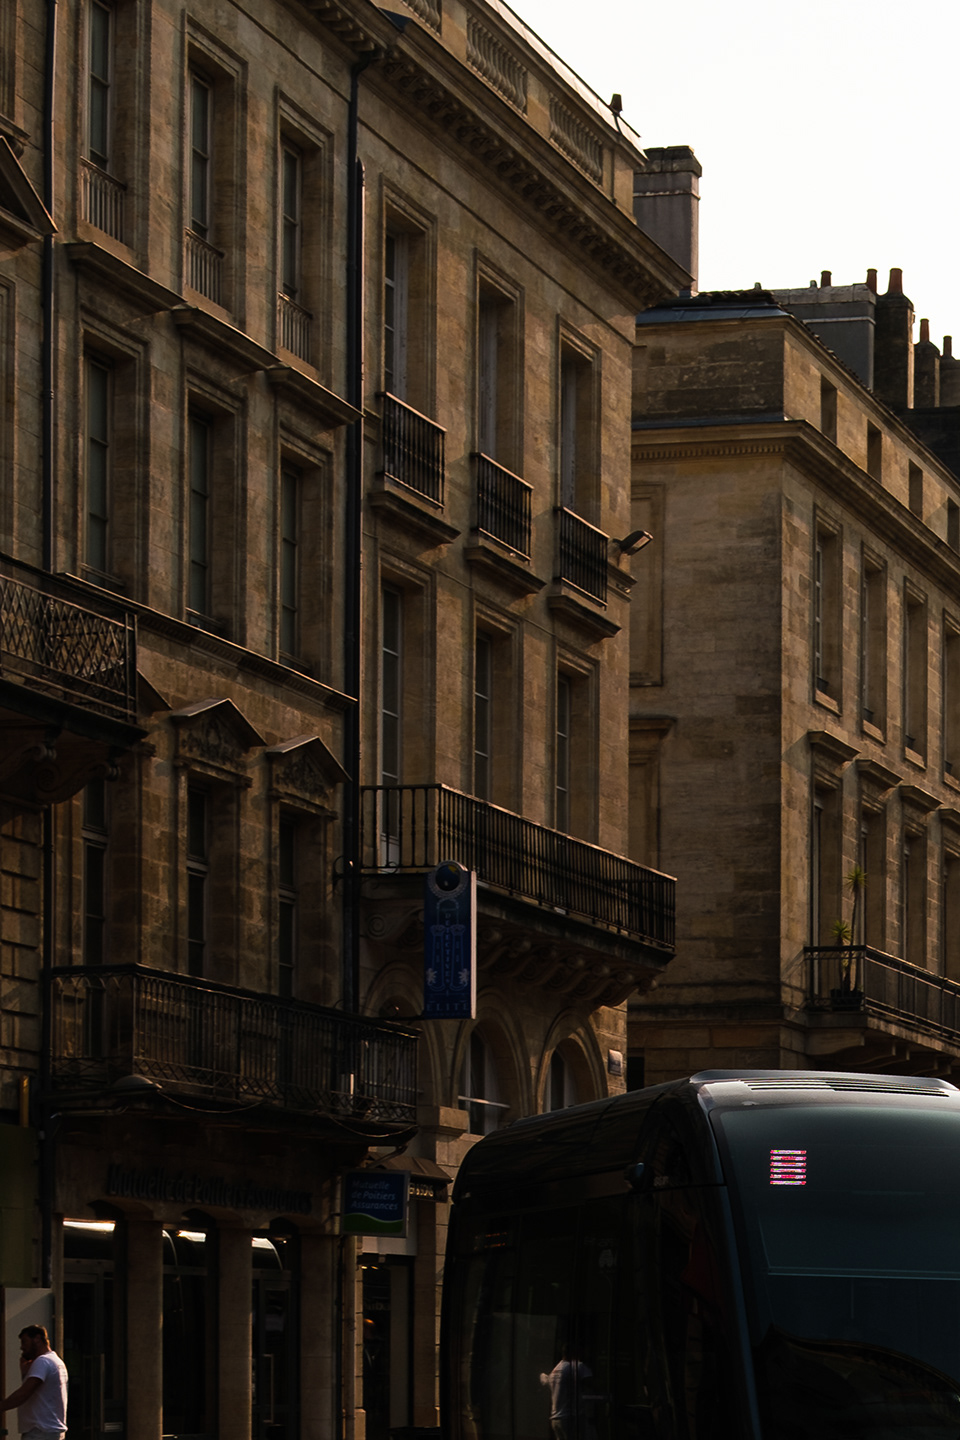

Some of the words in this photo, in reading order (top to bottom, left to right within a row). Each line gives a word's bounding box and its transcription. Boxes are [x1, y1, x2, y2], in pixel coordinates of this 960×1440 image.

[107, 1163, 174, 1200] Mutuelle
[351, 1179, 390, 1190] Mutuelle
[351, 1190, 362, 1199] de
[362, 1191, 396, 1201] Poitiers
[351, 1201, 399, 1211] Assurances
